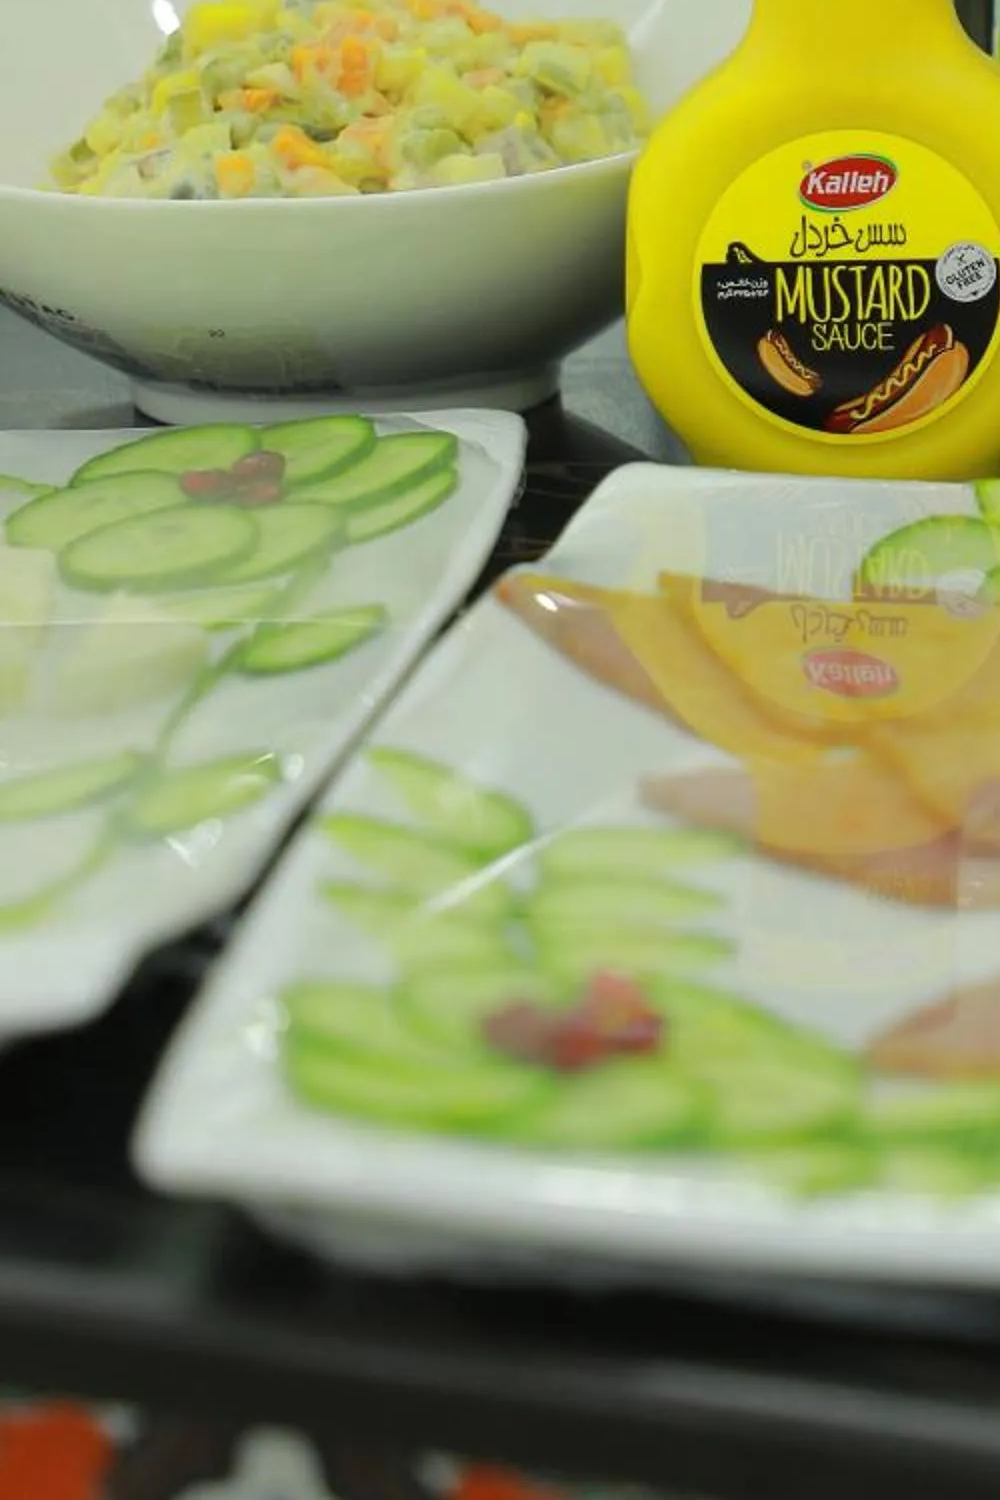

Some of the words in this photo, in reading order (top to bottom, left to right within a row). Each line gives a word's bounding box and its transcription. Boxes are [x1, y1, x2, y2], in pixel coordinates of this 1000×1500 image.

[806, 171, 889, 195] Kalleh
[790, 215, 855, 258] خردل
[945, 258, 986, 286] GLUTEN
[956, 271, 984, 290] FREE
[775, 262, 931, 324] MUSTARD
[811, 321, 895, 351] SAUCE
